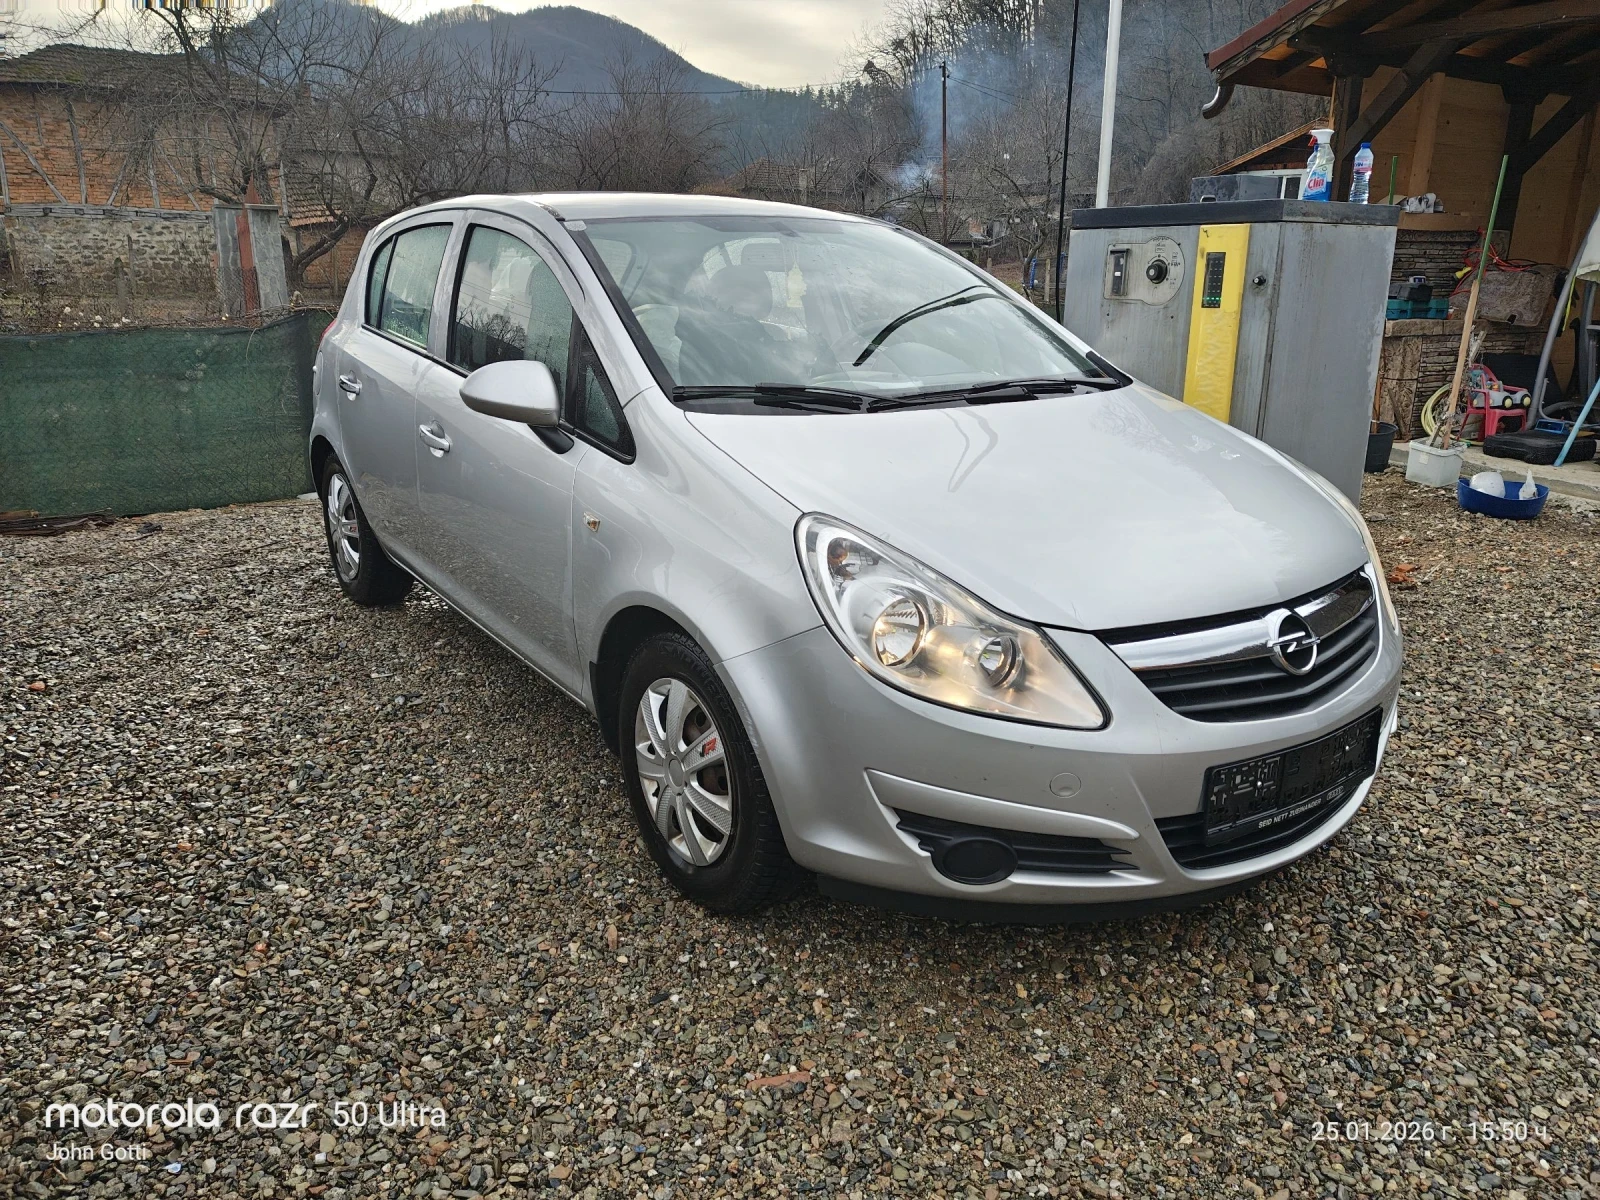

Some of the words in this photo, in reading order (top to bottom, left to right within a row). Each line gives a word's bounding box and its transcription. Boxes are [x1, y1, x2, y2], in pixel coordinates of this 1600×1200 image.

[1307, 176, 1325, 189] Clin
[1258, 818, 1273, 829] SEID
[1273, 812, 1289, 823] NETT
